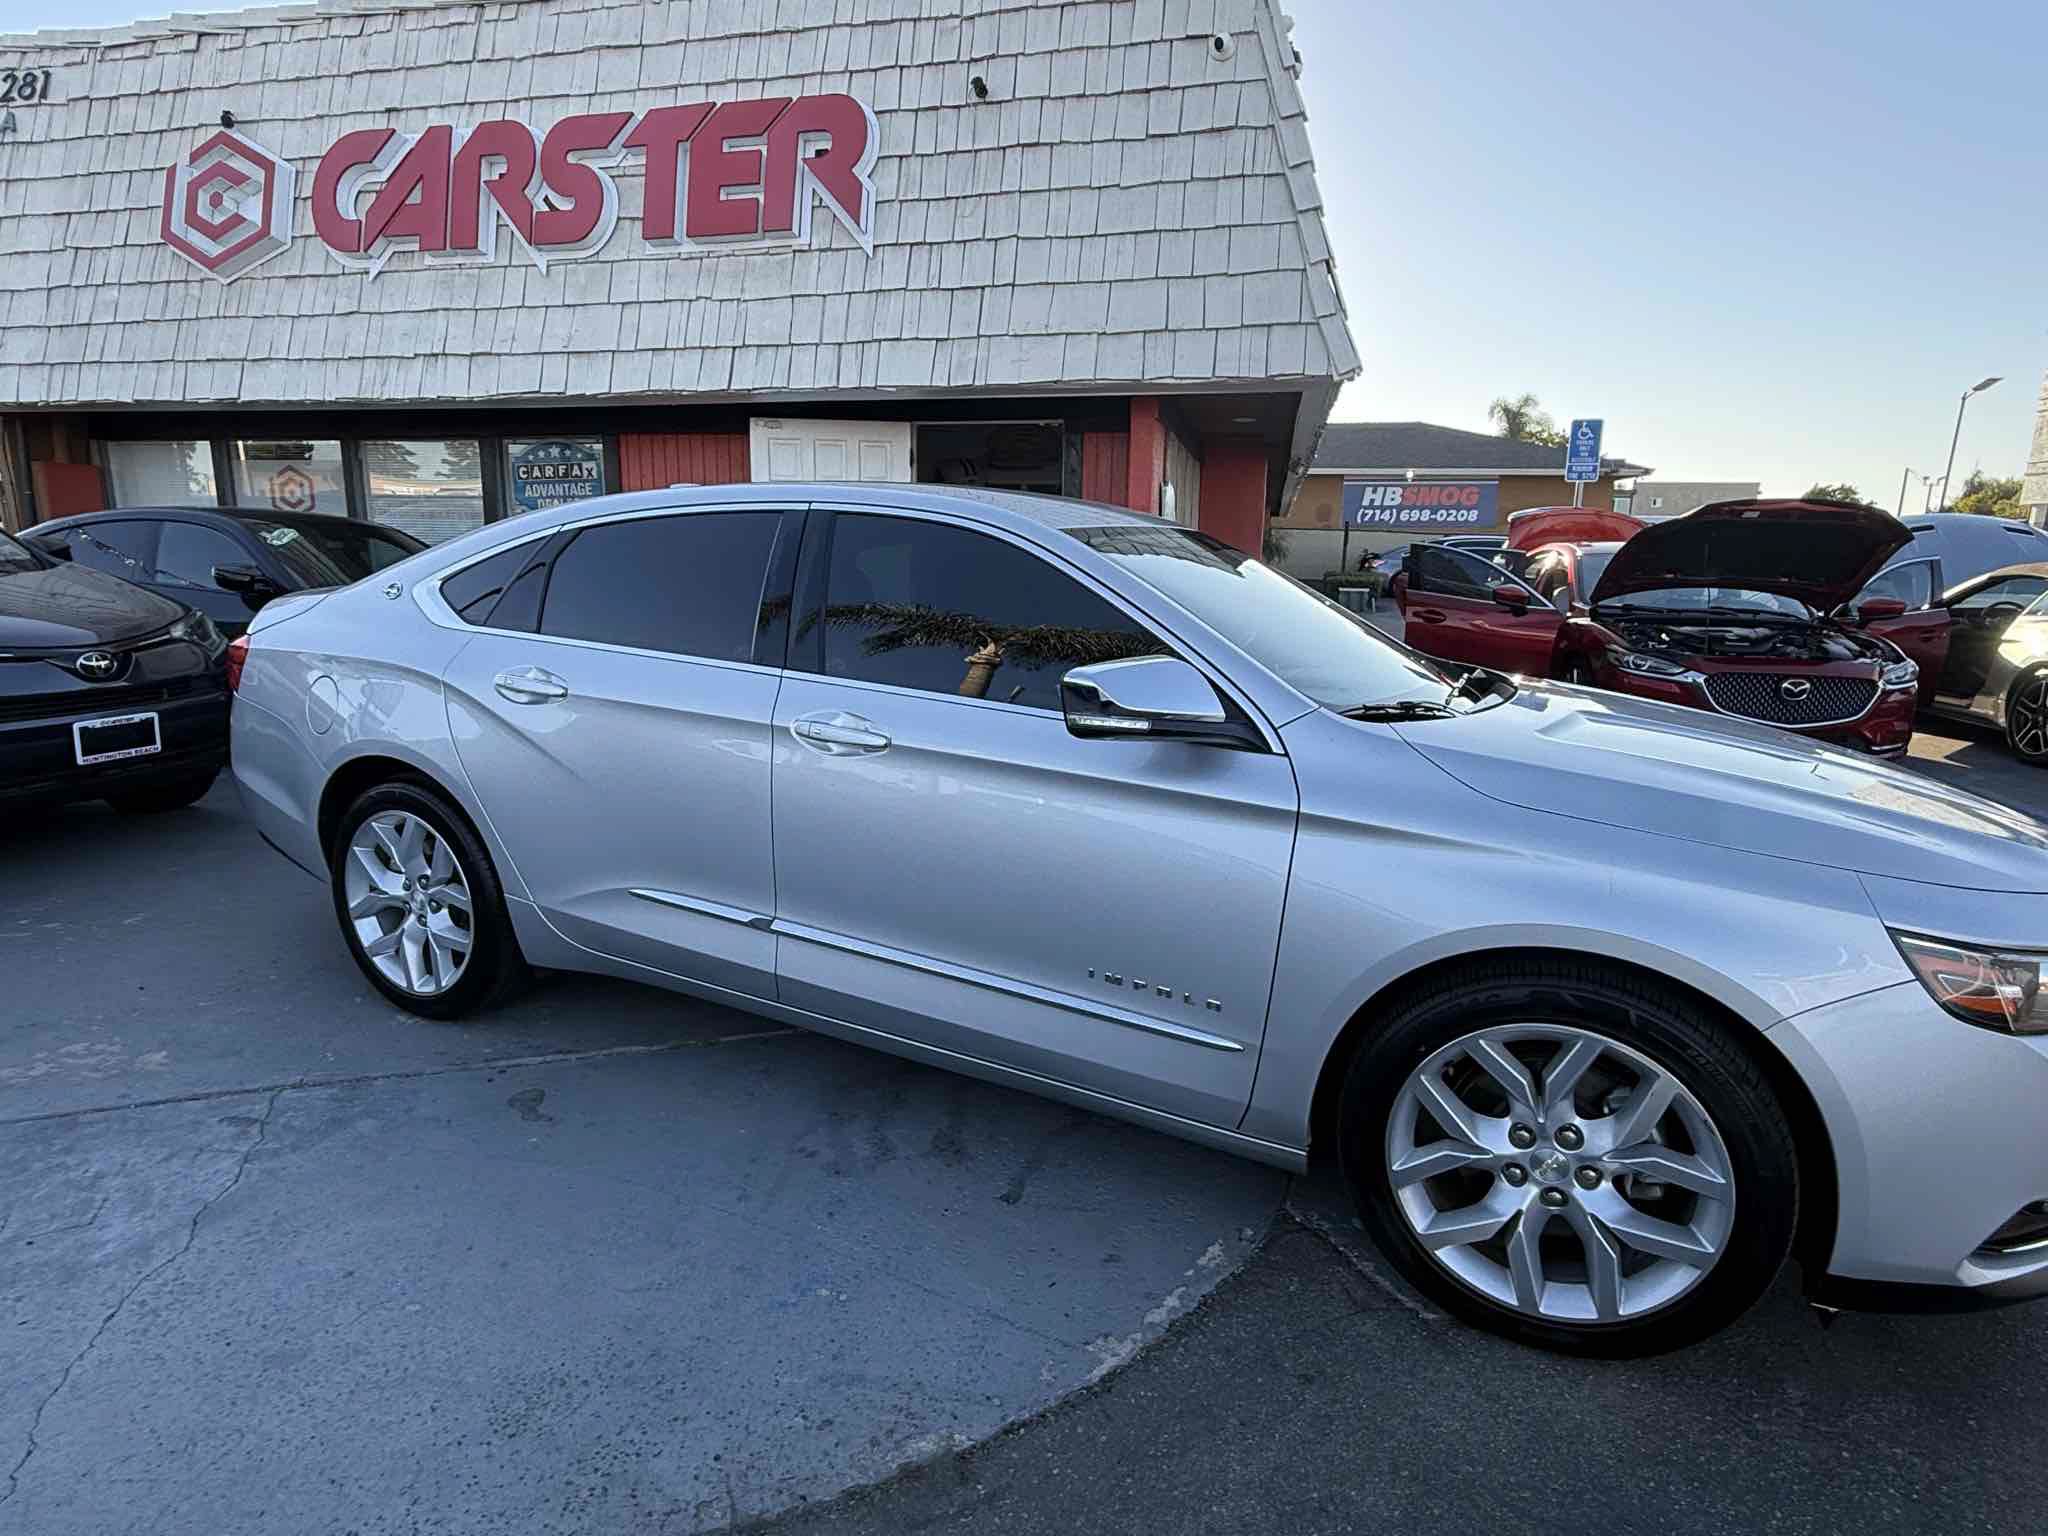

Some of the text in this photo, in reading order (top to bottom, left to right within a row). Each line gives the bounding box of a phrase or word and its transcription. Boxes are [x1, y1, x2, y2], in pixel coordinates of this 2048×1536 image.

[0, 70, 51, 102] 281
[311, 93, 878, 262] CARSTER
[518, 464, 595, 480] CARFAX
[525, 482, 593, 497] ADVANTAGE
[1356, 509, 1479, 525] (714) 698-0208
[1088, 967, 1223, 1013] IMPALA
